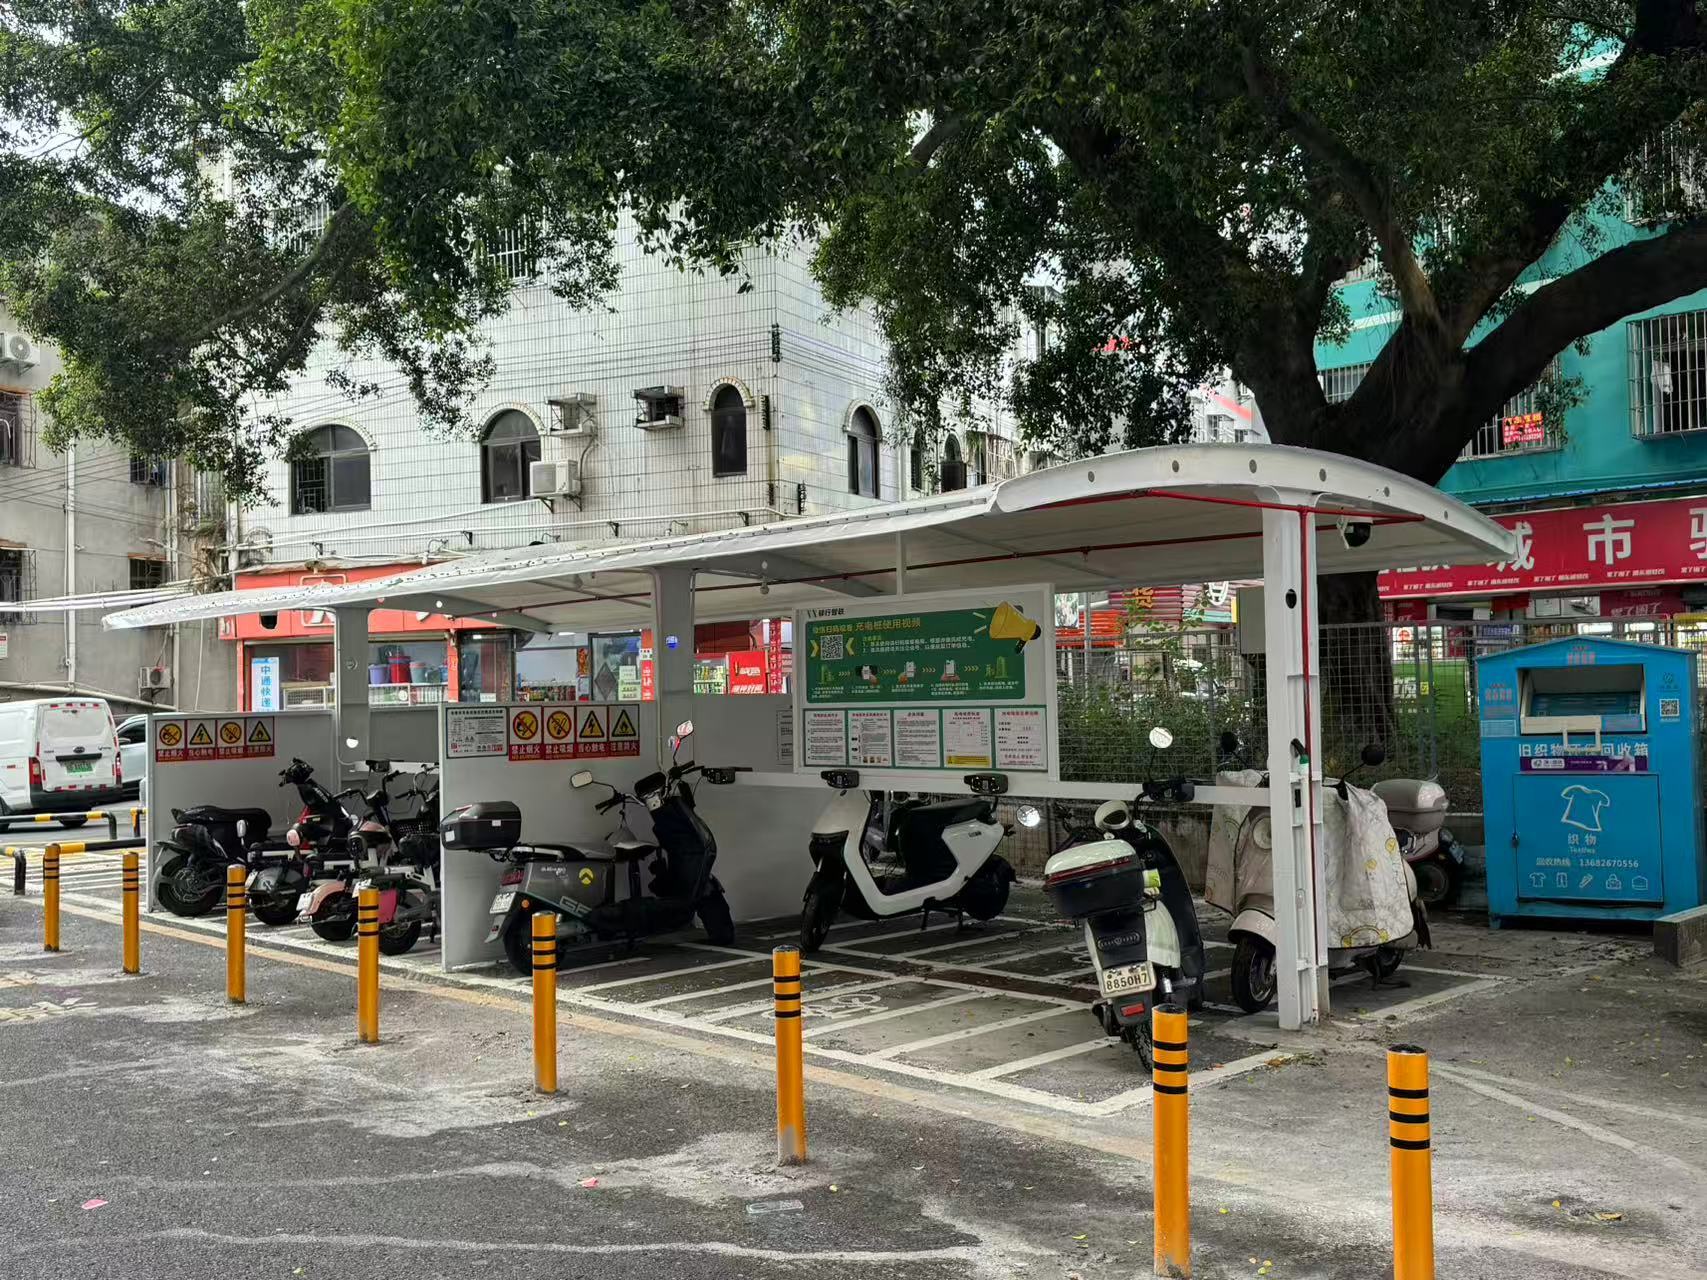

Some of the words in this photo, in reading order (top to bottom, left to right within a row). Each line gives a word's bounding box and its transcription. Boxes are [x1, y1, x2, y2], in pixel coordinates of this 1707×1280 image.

[511, 744, 541, 755] 禁止烟火
[545, 743, 574, 754] 禁止吸烟
[578, 742, 606, 753] 当心触电
[1567, 832, 1597, 846] 织物
[1106, 972, 1148, 991] 8850H7
